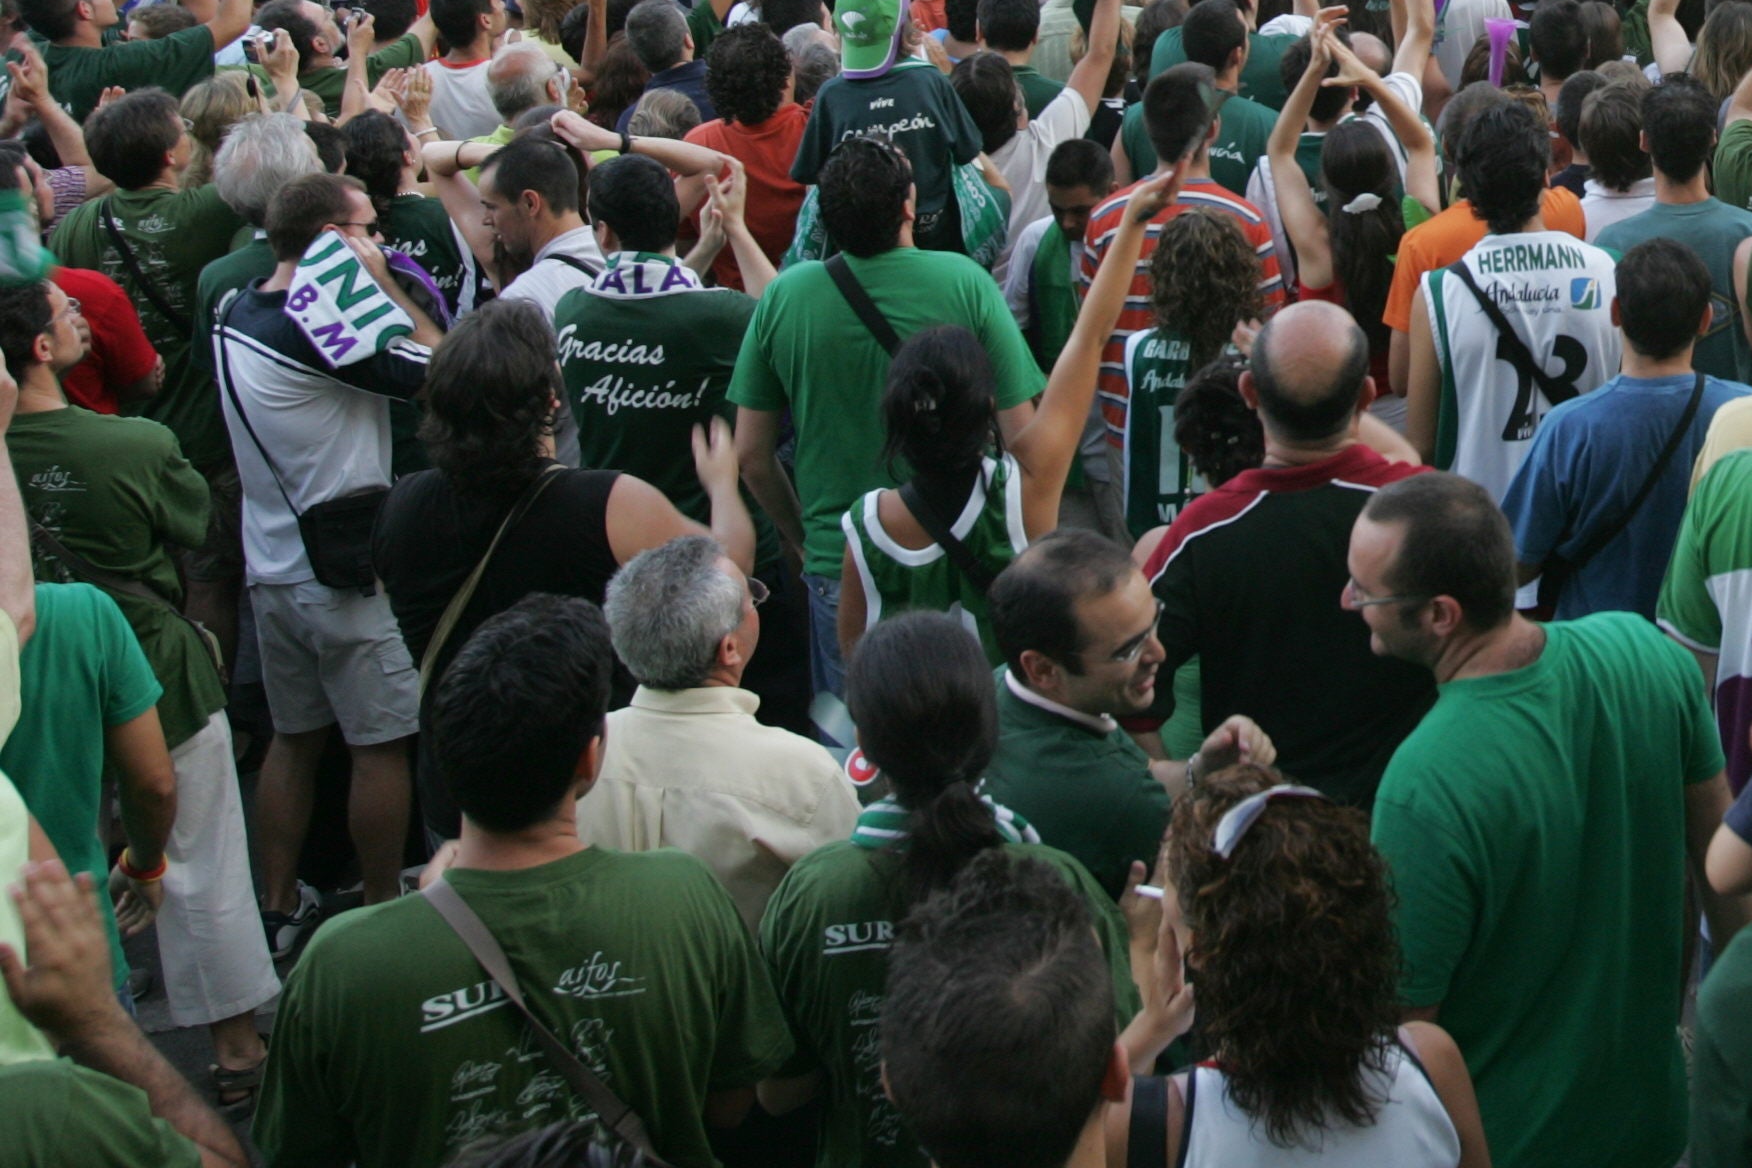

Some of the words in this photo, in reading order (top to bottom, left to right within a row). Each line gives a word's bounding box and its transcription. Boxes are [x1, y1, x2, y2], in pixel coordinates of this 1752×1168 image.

[1478, 243, 1586, 275] HERRMANN
[581, 374, 711, 415] Afición!
[824, 920, 895, 947] SUR
